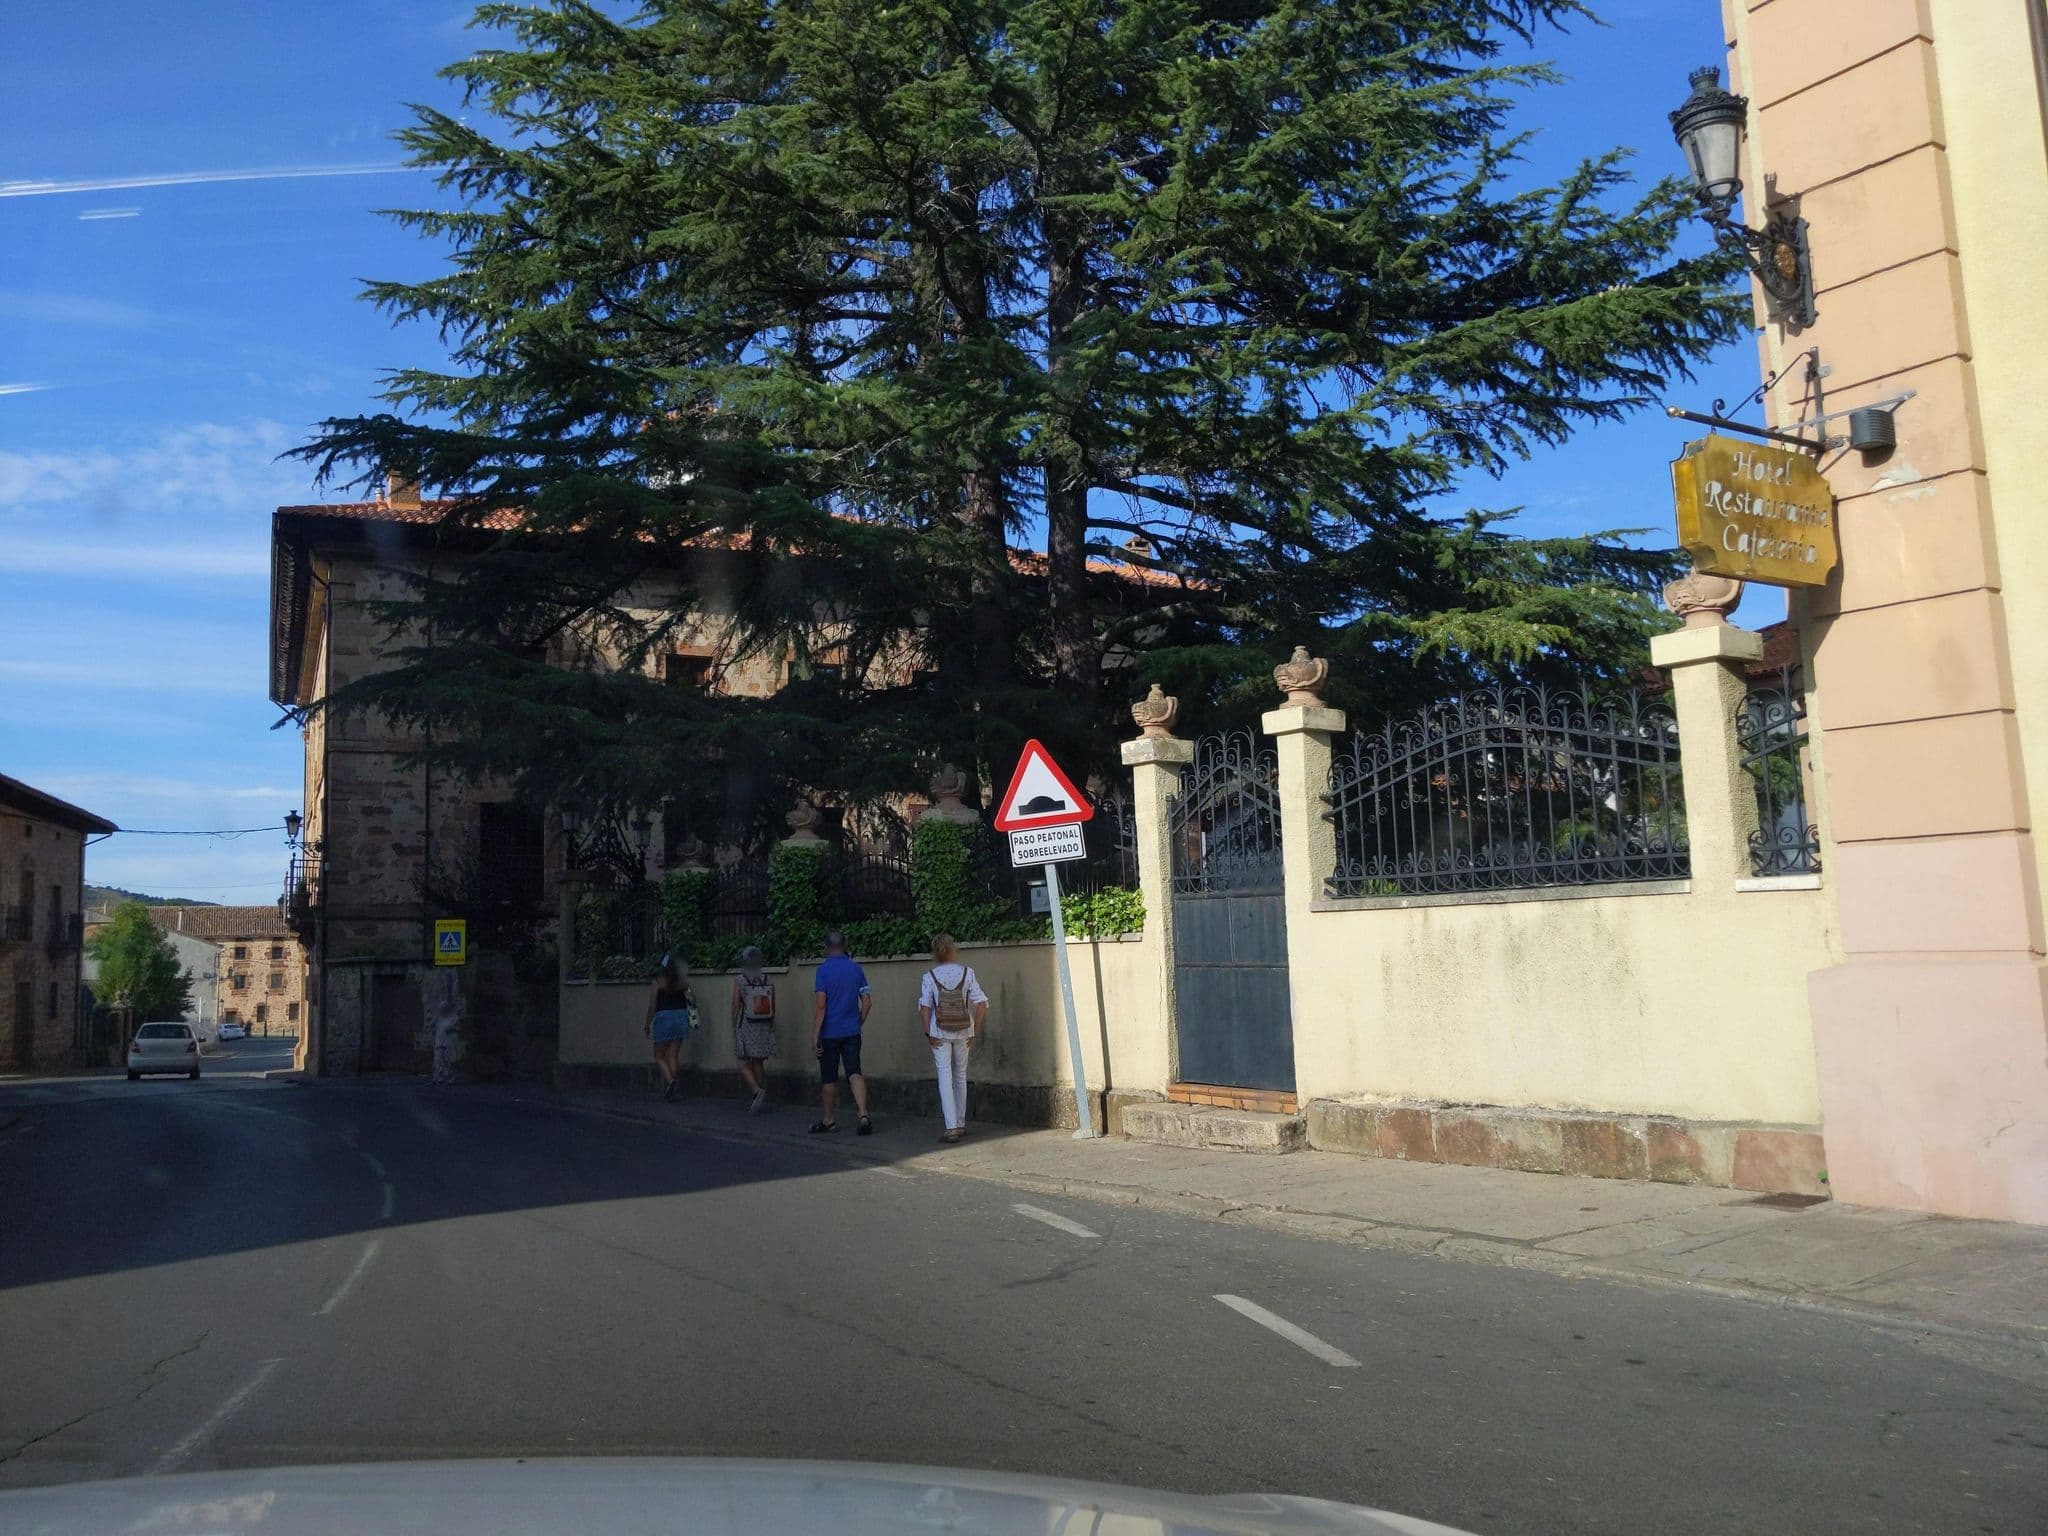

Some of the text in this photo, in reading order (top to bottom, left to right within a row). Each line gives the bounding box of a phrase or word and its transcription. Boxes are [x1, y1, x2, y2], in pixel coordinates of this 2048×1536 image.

[1732, 451, 1794, 485] Hotel
[1704, 480, 1828, 528] Restaurante
[1014, 829, 1079, 845] PASO PEATONAL
[1018, 843, 1079, 859] SOBREELEVADO
